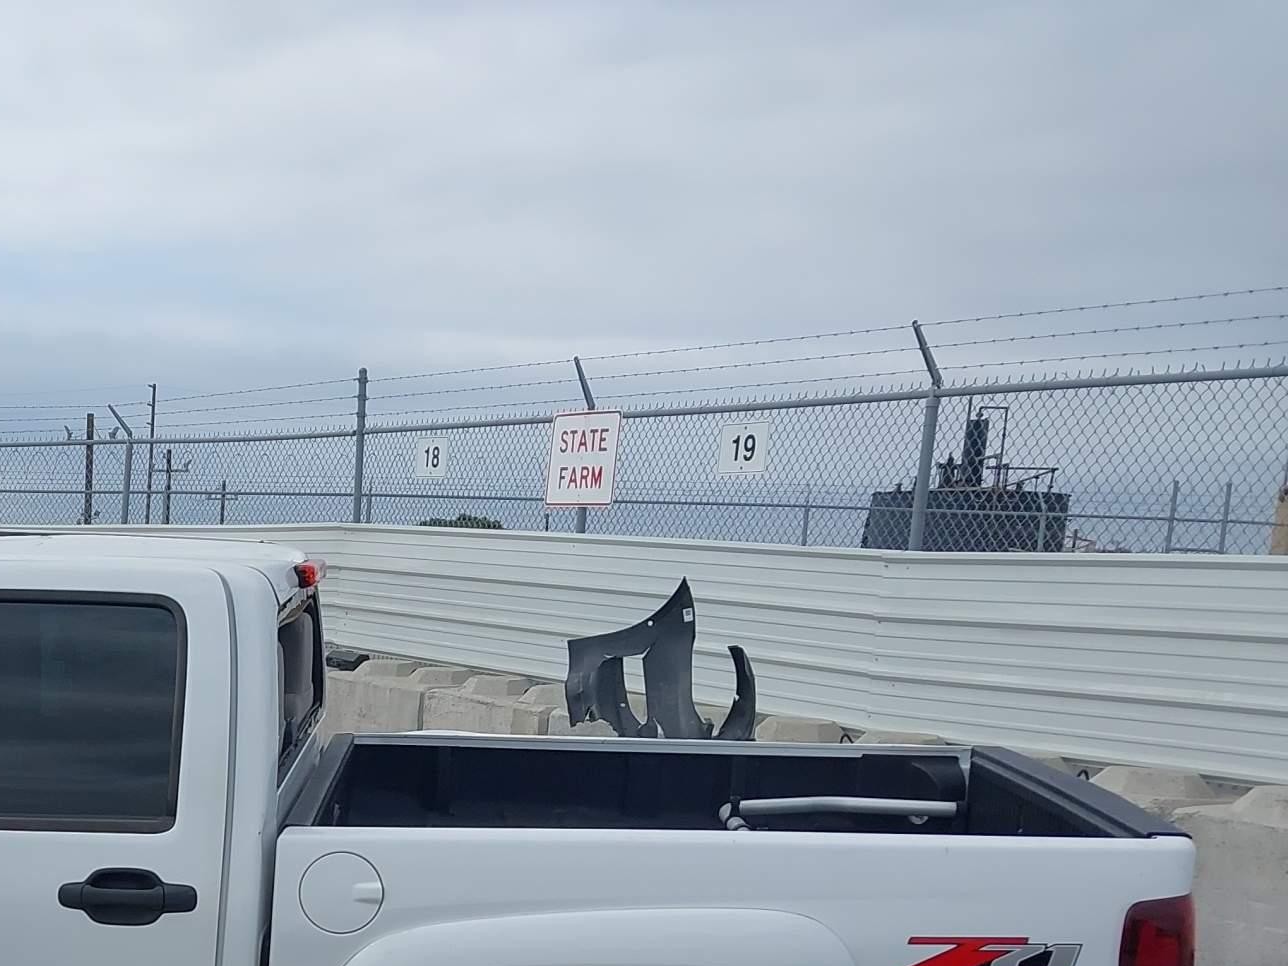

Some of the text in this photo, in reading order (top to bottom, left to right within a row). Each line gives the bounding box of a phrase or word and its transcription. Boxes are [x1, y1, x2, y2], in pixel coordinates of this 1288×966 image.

[559, 428, 609, 453] STATE
[732, 434, 756, 462] 19
[424, 446, 440, 468] 18
[558, 465, 603, 489] FARM
